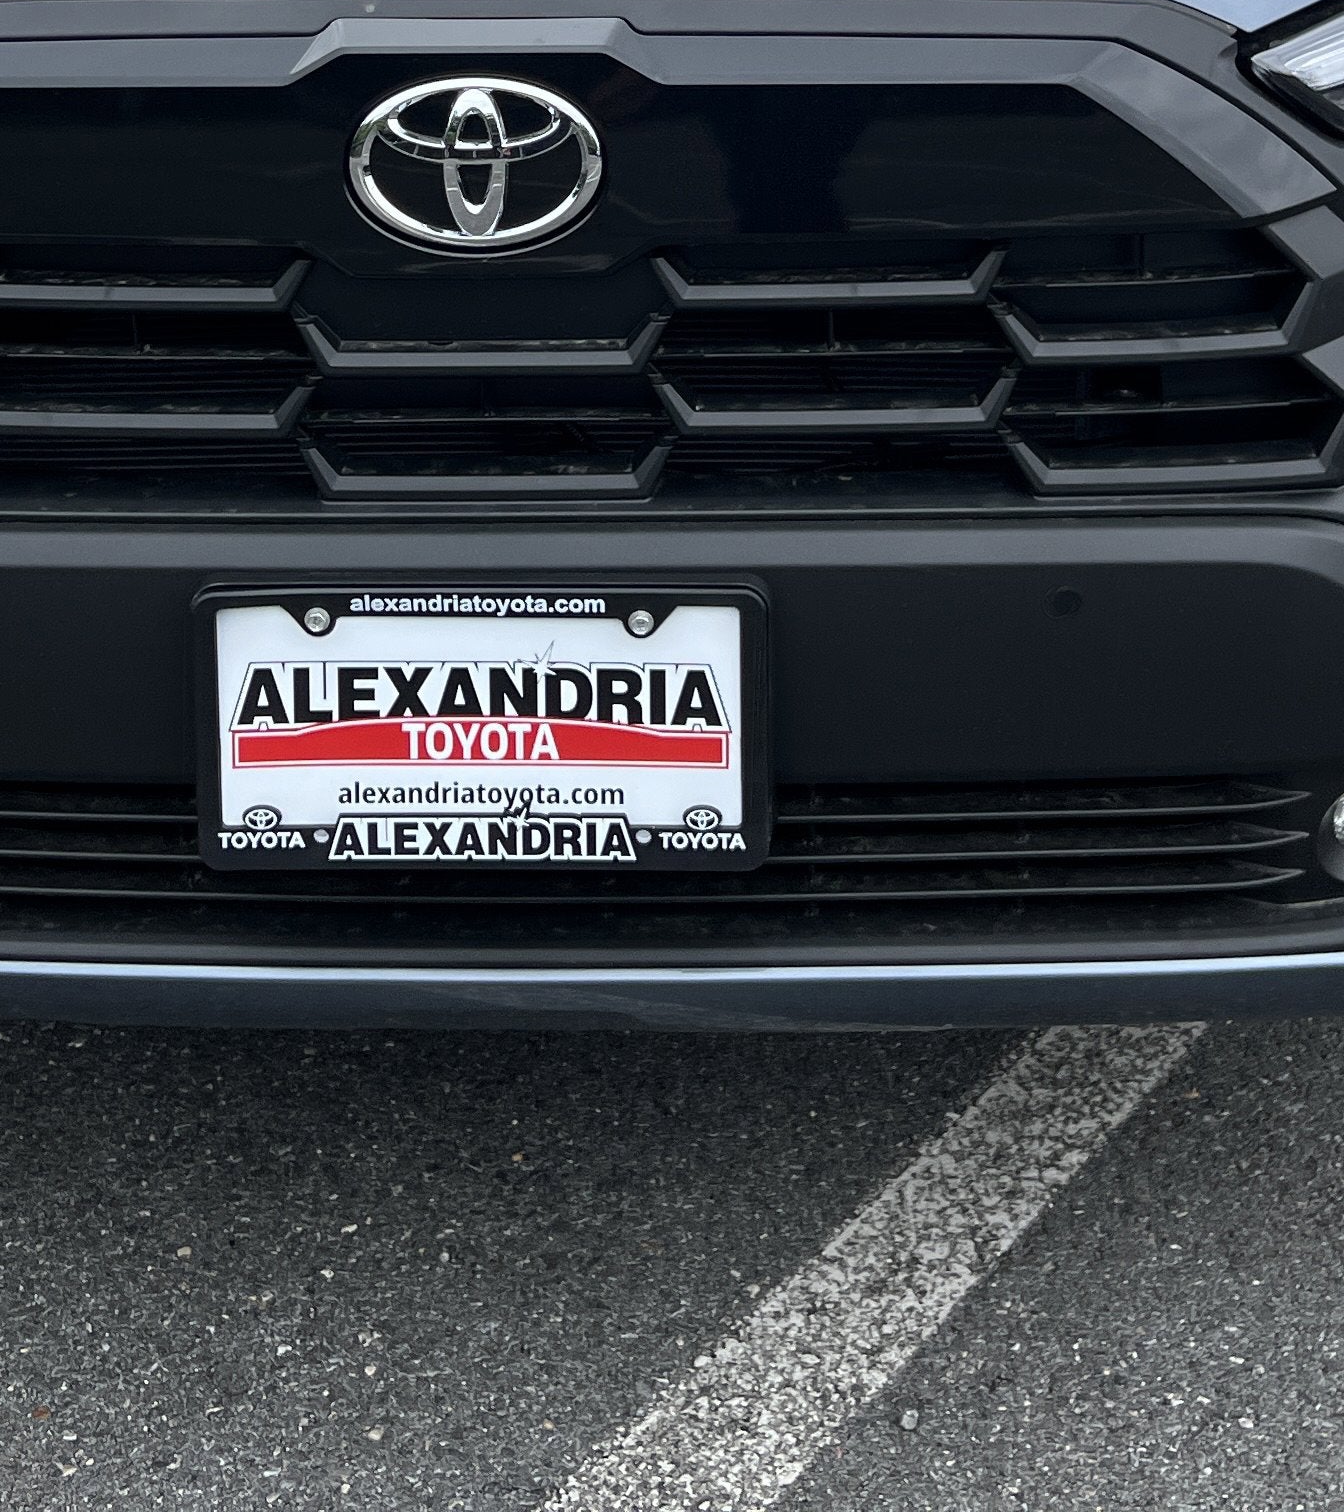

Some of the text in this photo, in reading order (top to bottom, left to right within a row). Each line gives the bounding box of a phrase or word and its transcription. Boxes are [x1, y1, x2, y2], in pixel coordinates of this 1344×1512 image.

[349, 594, 606, 616] alexandriatoyota.com
[236, 662, 726, 726] ALEXANDRIA
[401, 722, 560, 761] TOYOTA
[338, 781, 625, 811] alexandriatoyota.com
[218, 831, 306, 850] TOYOTA
[331, 819, 634, 858] ALEXANDRIA
[659, 831, 747, 851] TOYOTA
